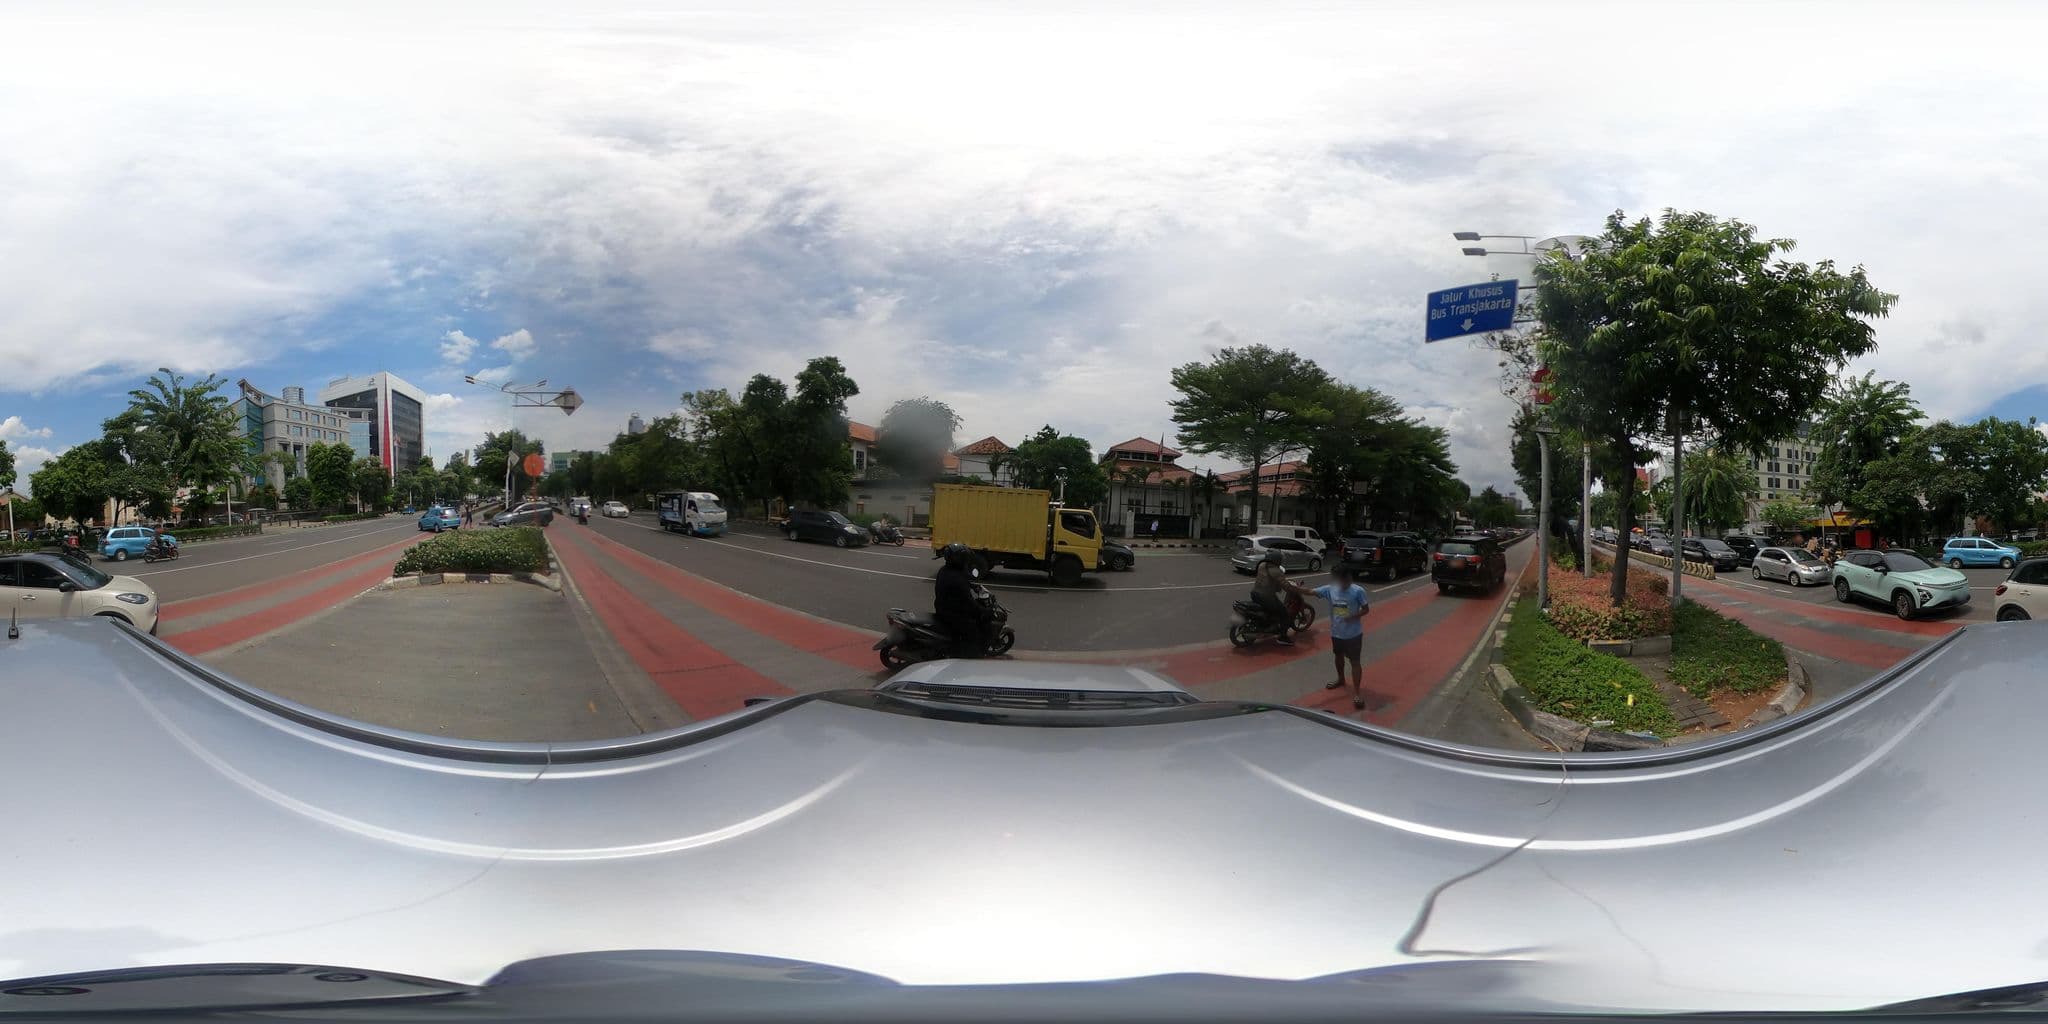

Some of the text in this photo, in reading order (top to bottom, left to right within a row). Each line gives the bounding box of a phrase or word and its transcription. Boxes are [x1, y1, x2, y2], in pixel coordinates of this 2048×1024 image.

[1440, 286, 1503, 304] Jalur Khusus
[1431, 298, 1512, 320] Bus Transjakarta
